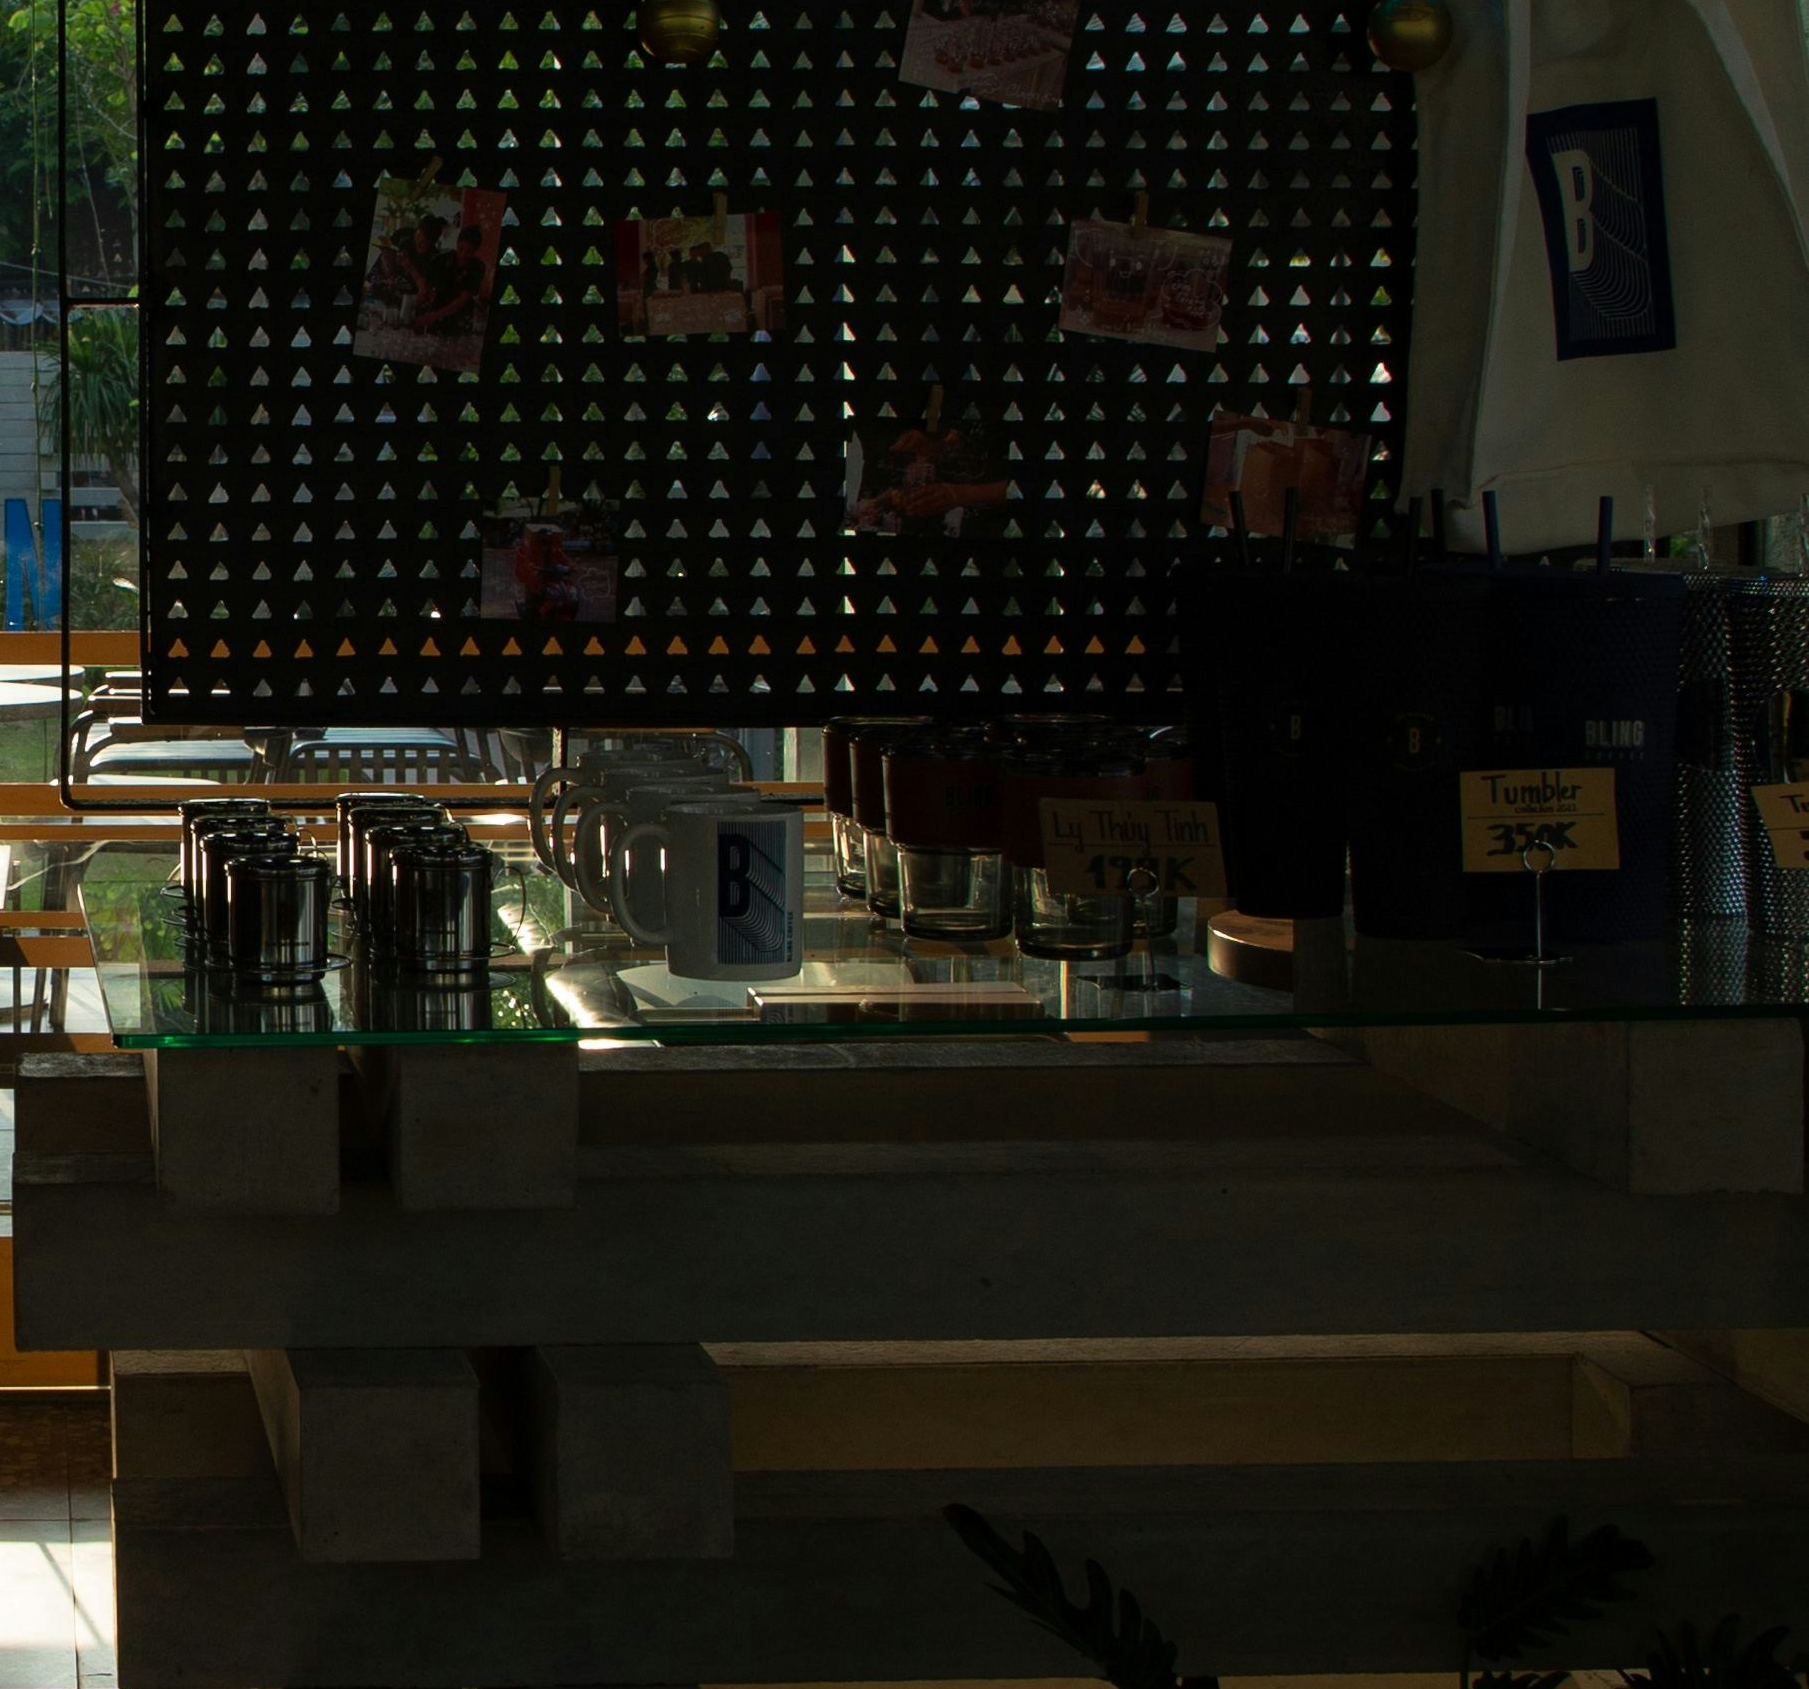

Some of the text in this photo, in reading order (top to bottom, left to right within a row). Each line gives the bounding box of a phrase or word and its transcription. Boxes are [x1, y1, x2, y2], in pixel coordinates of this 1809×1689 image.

[1584, 719, 1646, 748] BLING
[1480, 770, 1583, 806] Tumbler
[1052, 811, 1086, 854] Ly
